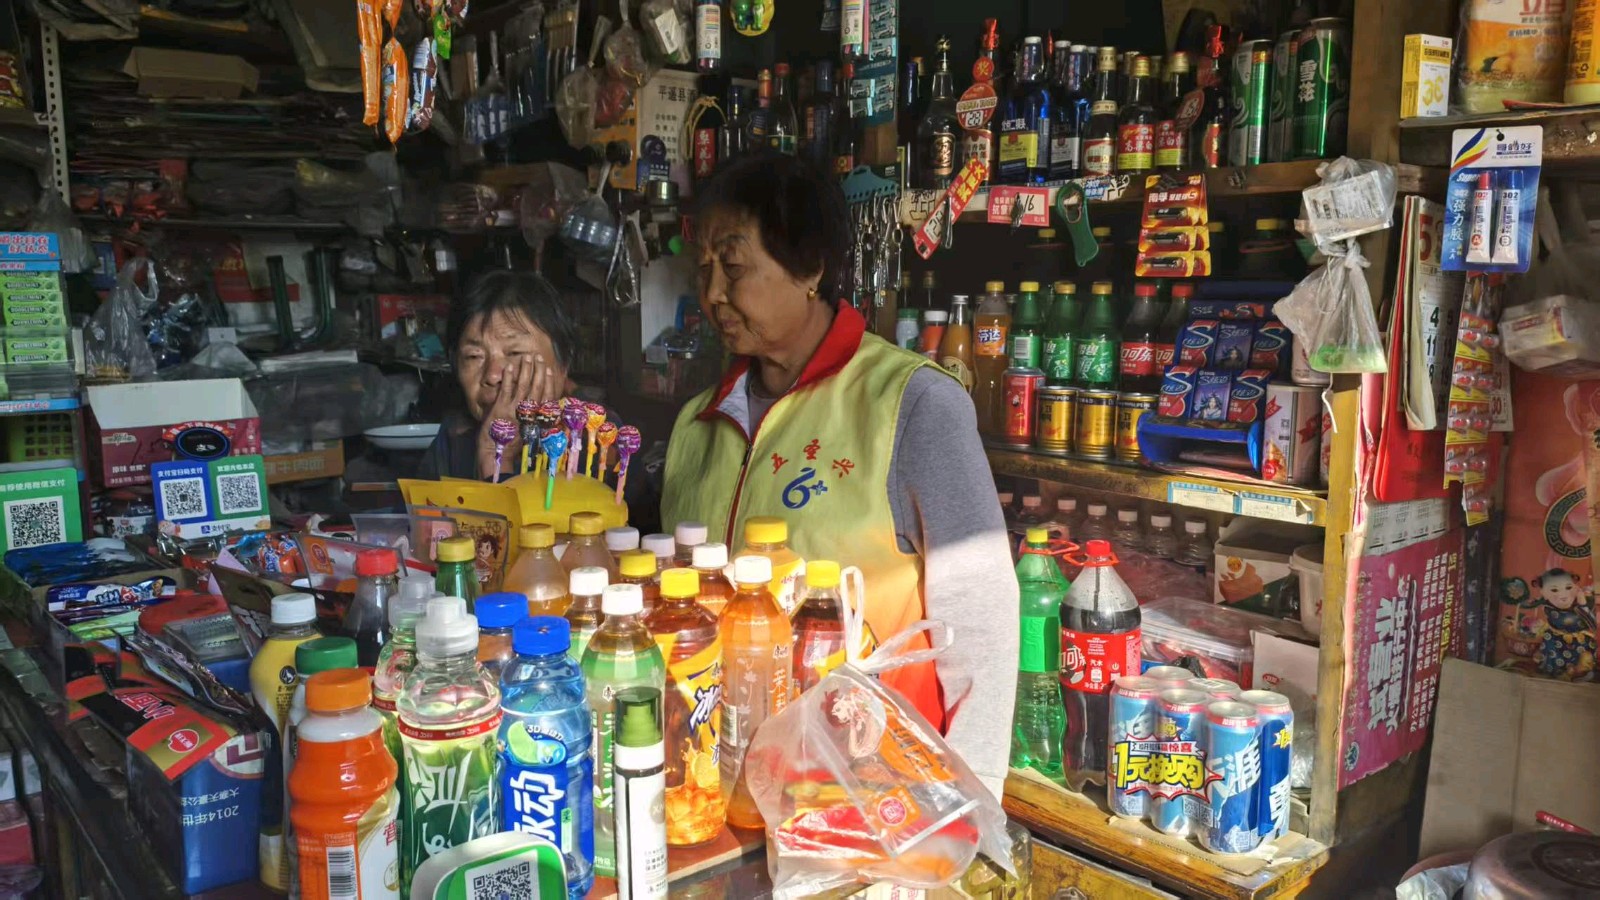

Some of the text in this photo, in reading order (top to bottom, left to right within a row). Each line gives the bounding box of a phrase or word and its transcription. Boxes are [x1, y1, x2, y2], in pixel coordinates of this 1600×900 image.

[1298, 59, 1318, 103] 雪花
[1148, 192, 1169, 203] 南孚
[1502, 191, 1519, 199] 302
[1449, 199, 1467, 241] 强力胶
[1430, 306, 1440, 328] 4
[977, 329, 1001, 342] 芬达
[1426, 335, 1438, 357] 11
[1090, 659, 1104, 667] 汽水
[1115, 741, 1206, 790] 1元换购
